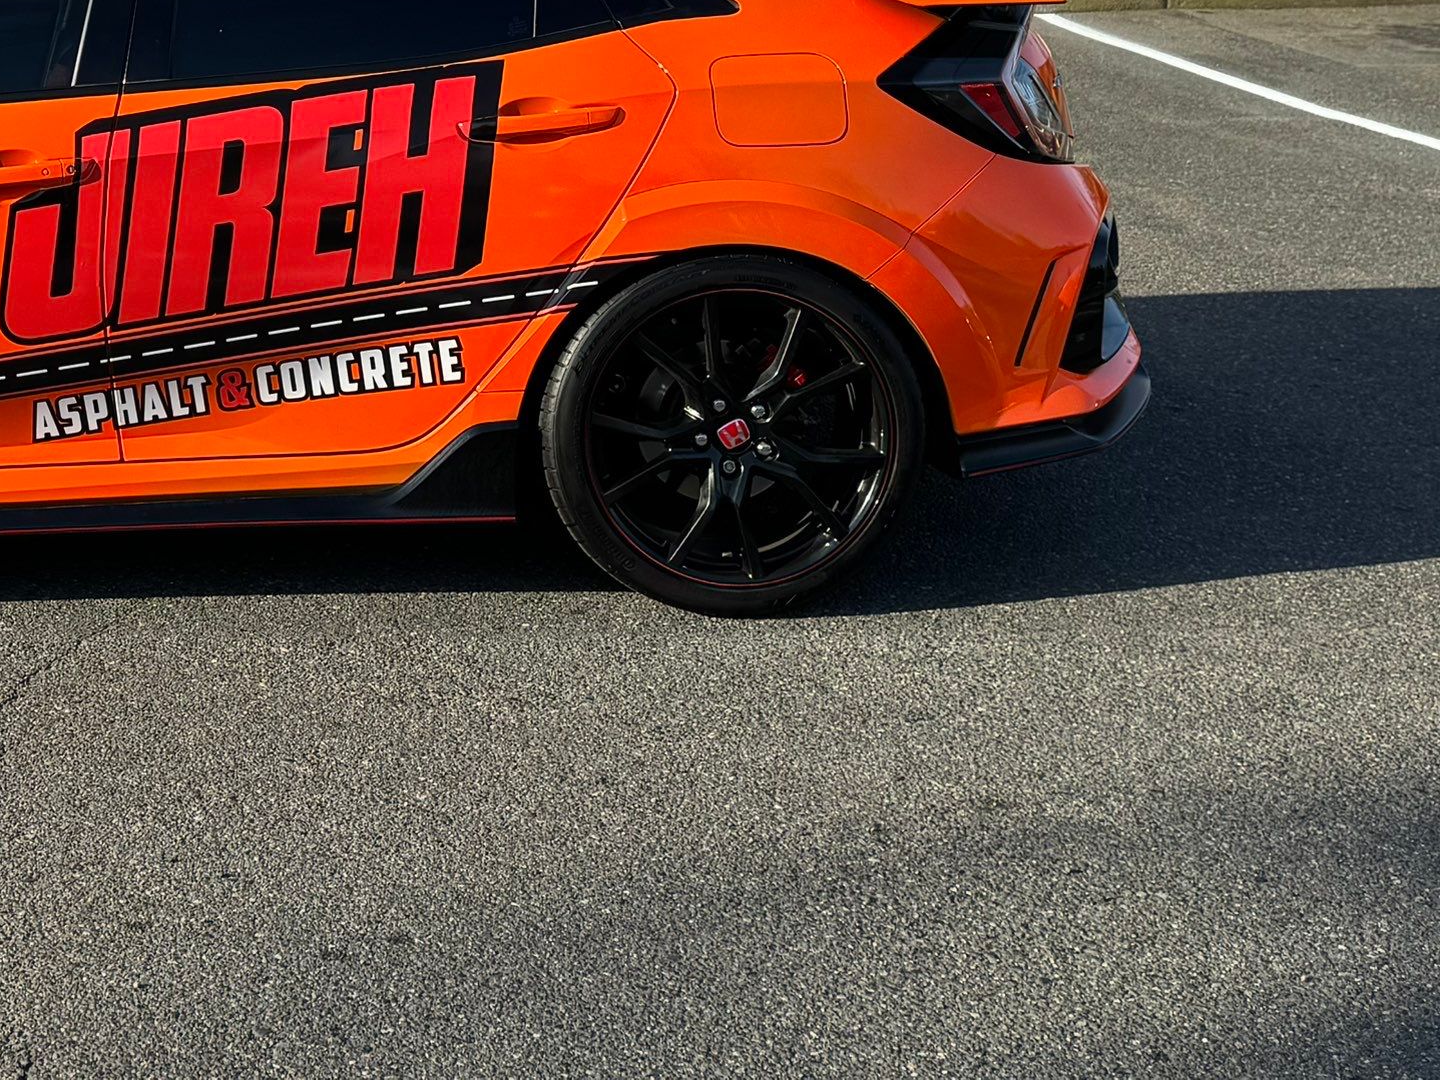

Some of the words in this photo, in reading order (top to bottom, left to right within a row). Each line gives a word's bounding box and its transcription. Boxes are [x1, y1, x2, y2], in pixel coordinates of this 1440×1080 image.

[1, 70, 486, 342] JIREH
[34, 374, 210, 442] ASPHALT
[218, 371, 250, 412] &
[255, 337, 465, 406] CONCRETE
